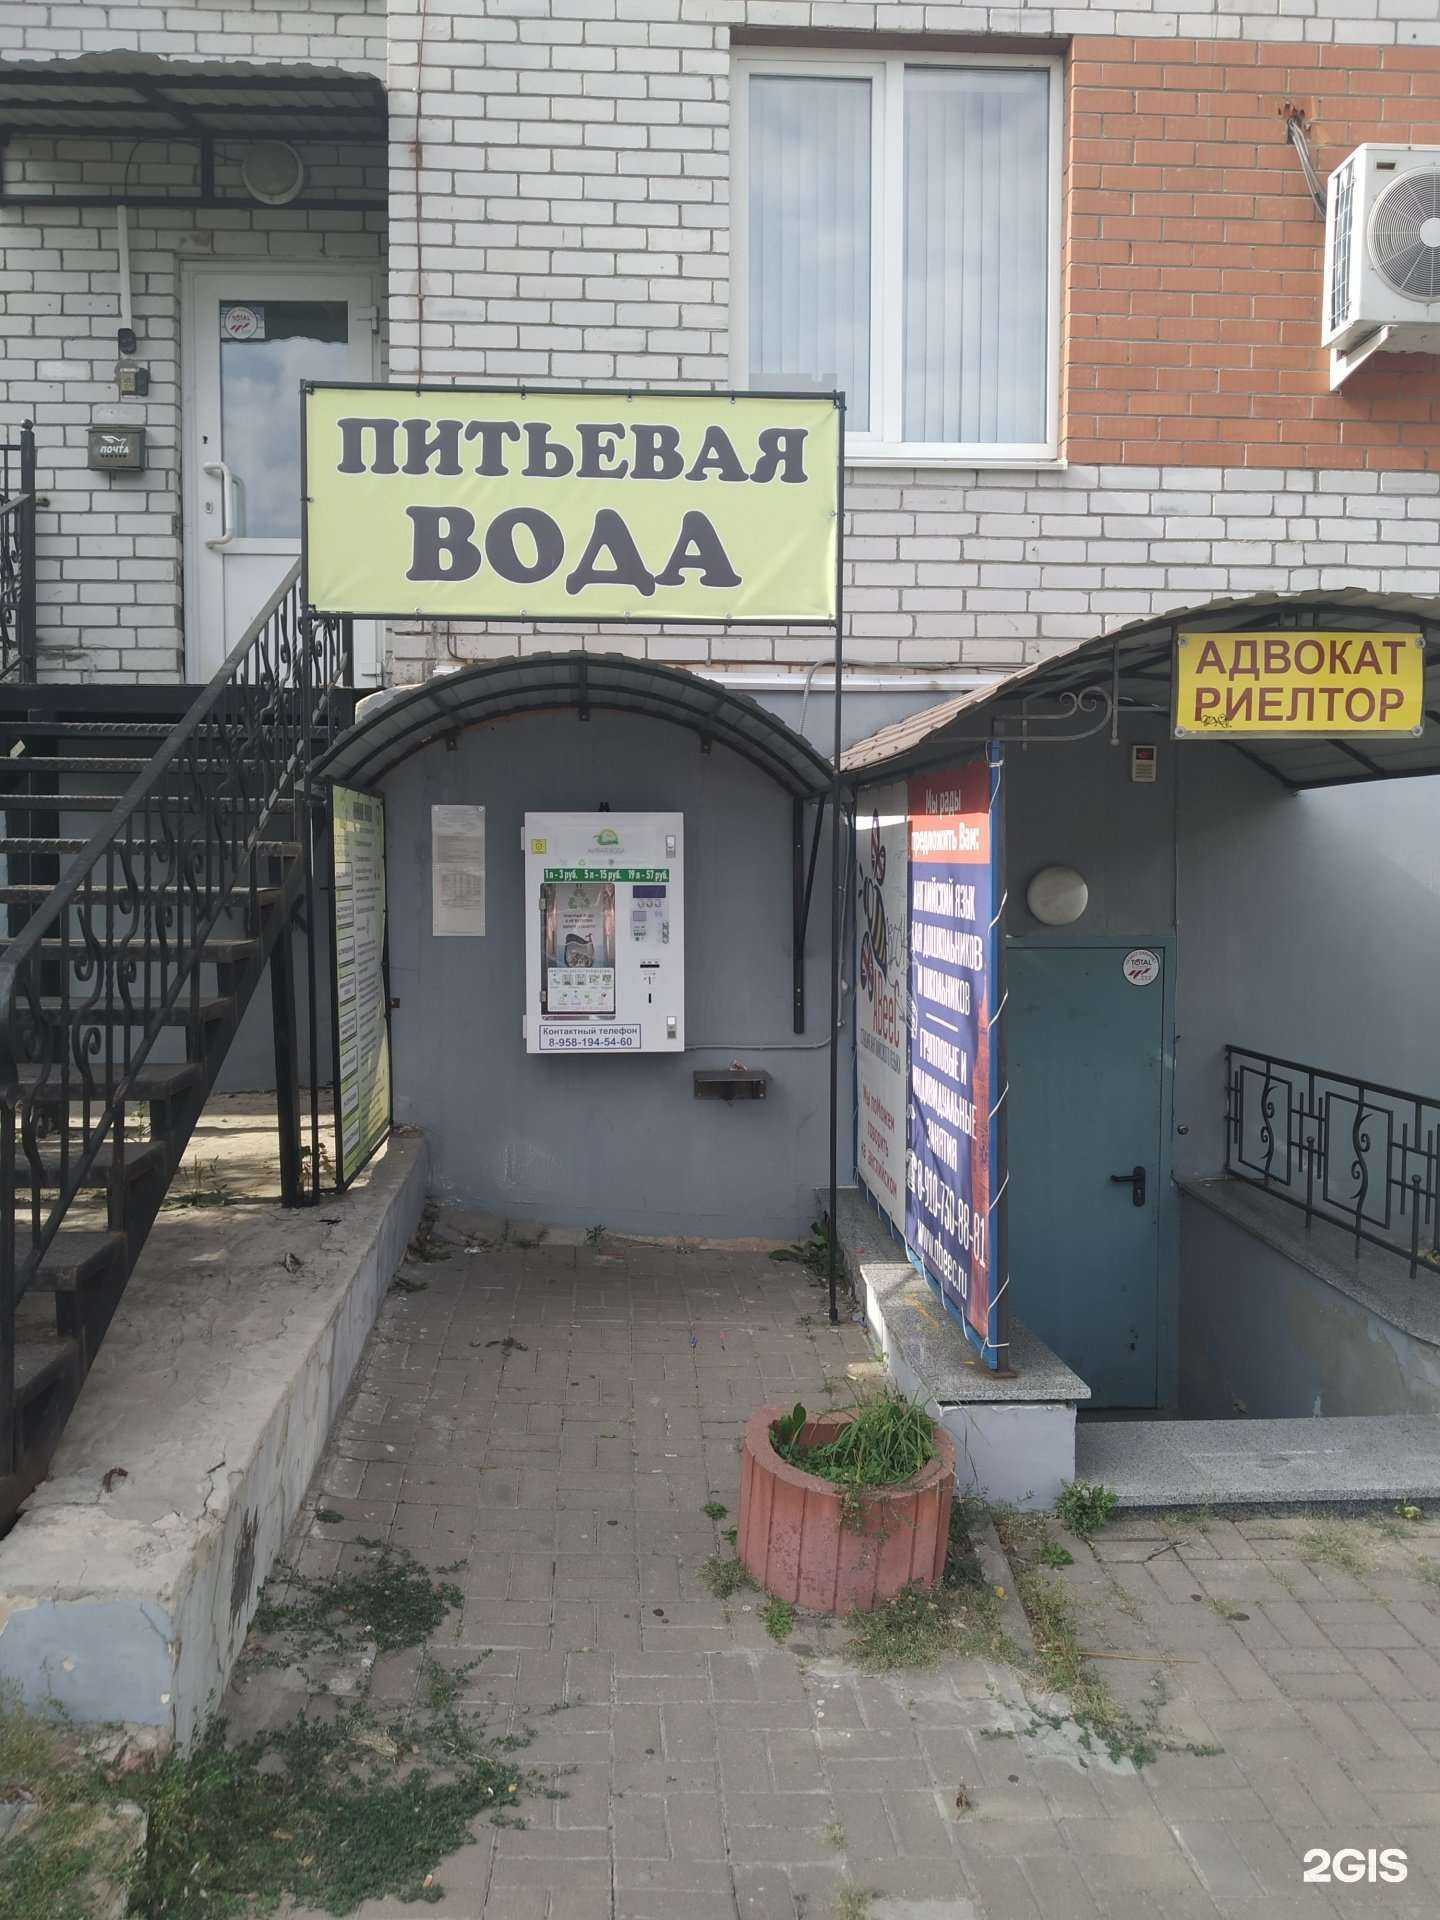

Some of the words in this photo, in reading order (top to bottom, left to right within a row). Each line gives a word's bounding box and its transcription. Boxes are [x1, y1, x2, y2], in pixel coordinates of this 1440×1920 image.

[336, 417, 810, 485] ПИТЬЕВАЯ
[404, 504, 744, 598] ВОДА
[1194, 639, 1407, 682] АДВОКАТ
[1193, 686, 1406, 723] РИЕЛТОР
[925, 788, 939, 816] Мы
[940, 788, 961, 821] рады
[911, 829, 957, 856] предложить
[564, 870, 578, 881] руб.
[599, 870, 607, 879] 15
[608, 870, 622, 881] руб.
[646, 870, 654, 879] 57
[655, 870, 669, 881] руб.
[912, 876, 954, 918] АНГЛИЙСКИЙ
[955, 884, 976, 921] ЯЗЫК
[922, 923, 983, 972] ДОШКОЛЬНИКОВ
[917, 963, 923, 996] И
[923, 965, 970, 1016] ШКОЛЬНИКОВ
[543, 1027, 597, 1036] Контактный
[599, 1027, 638, 1036] телефон
[548, 1037, 633, 1047] 8-958-194-54-60
[919, 1026, 960, 1083] ГРУППОВЫЕ
[960, 1049, 968, 1086] И
[912, 1064, 978, 1141] ИНДИВИДУАЛЬНЫЕ
[926, 1117, 958, 1173] ЗАНЯТИЯ
[917, 1159, 986, 1269] 8-910-730-88-81
[917, 1217, 968, 1301] www.abeec.ru
